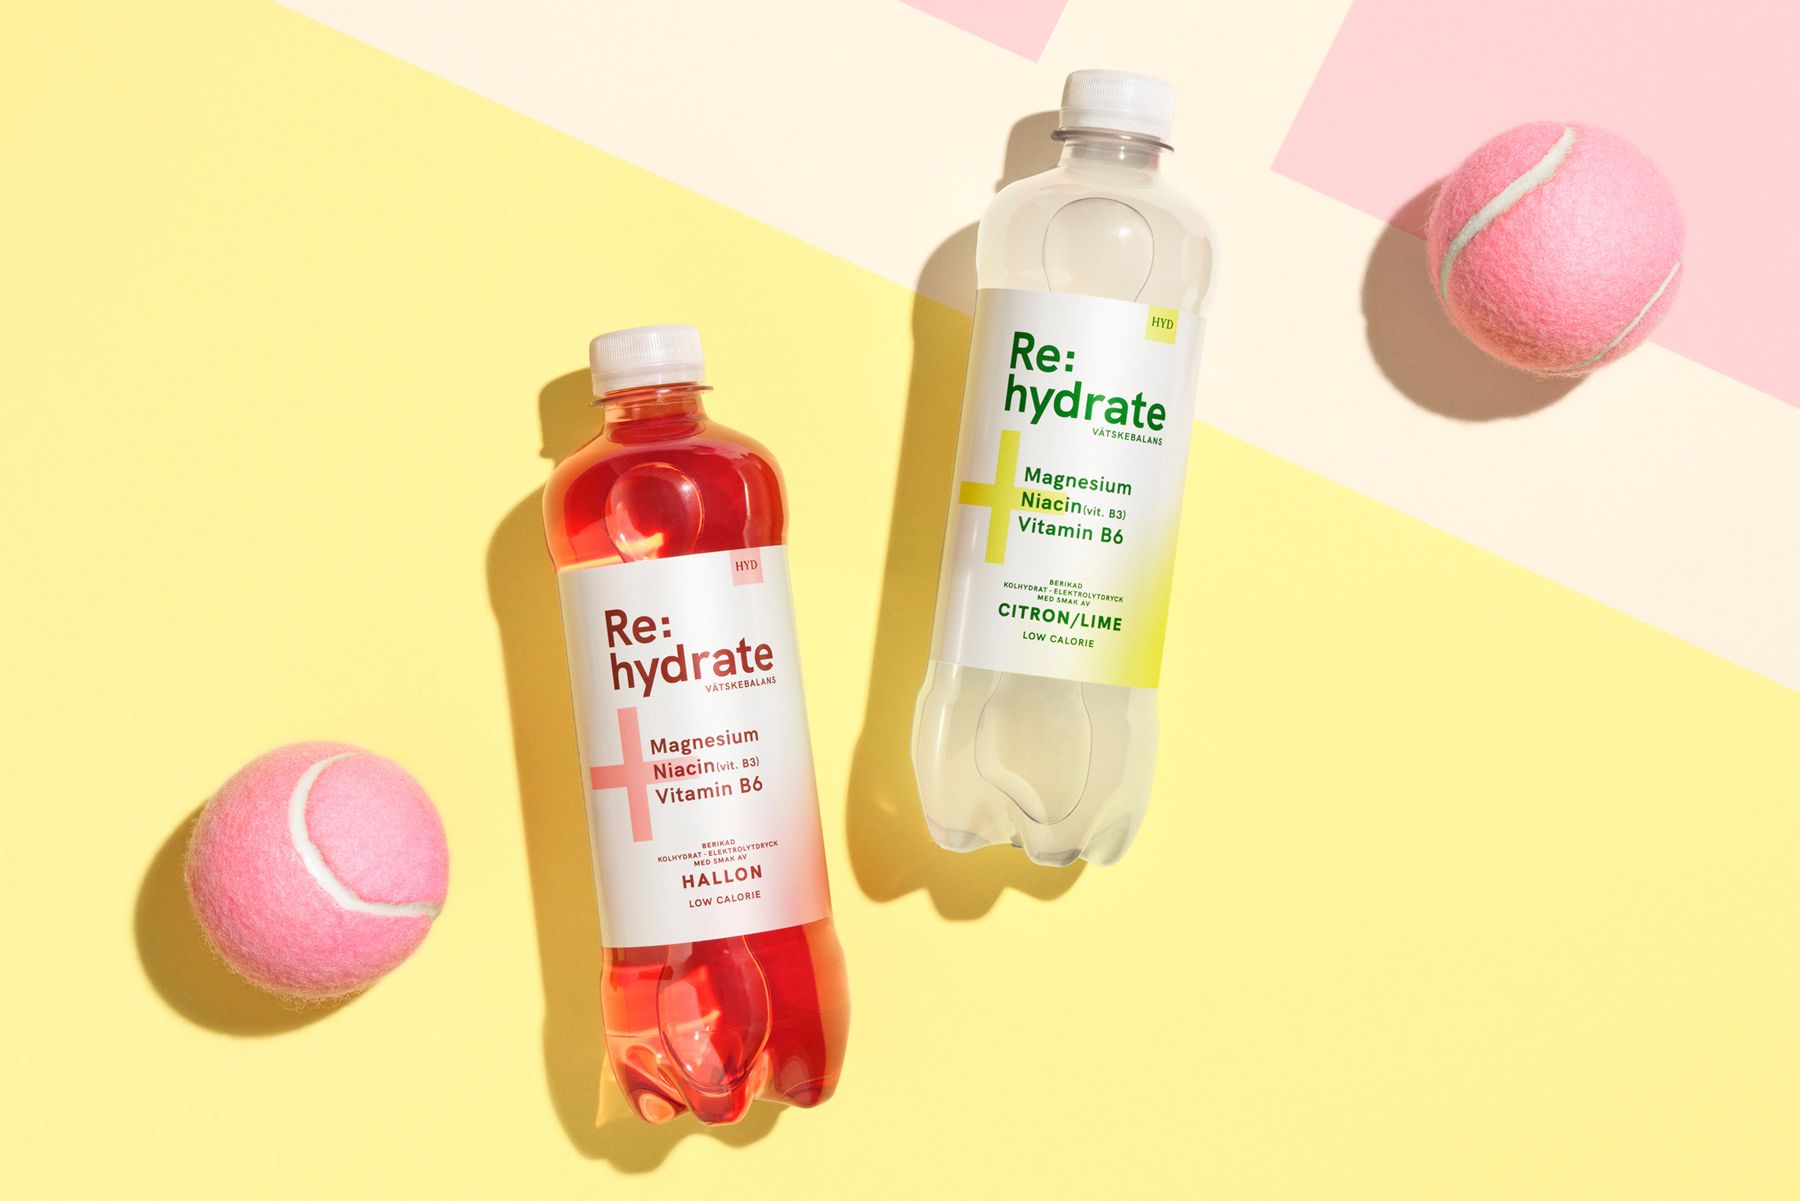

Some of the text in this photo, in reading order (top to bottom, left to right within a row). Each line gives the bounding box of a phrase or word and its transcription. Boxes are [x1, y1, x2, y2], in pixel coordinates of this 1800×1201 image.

[1152, 316, 1174, 330] HYD
[1010, 331, 1075, 373] Re:
[1004, 374, 1166, 432] hydrate
[1092, 427, 1163, 446] VÄTSKEBALANS
[1024, 466, 1132, 496] Magnesium
[1108, 508, 1127, 521] B3)
[1018, 515, 1124, 545] Vitamin B6
[735, 559, 758, 572] HYD
[1049, 579, 1083, 589] BERIKAD
[1037, 594, 1054, 602] MED
[1056, 596, 1078, 605] SMAK
[998, 602, 1123, 632] CITRON/LIME
[604, 608, 672, 648] Re:
[1022, 631, 1095, 648] LOW CALORIE
[610, 637, 774, 698] hydrate
[705, 675, 777, 694] VÄTSKEBALANS
[650, 729, 760, 756] Magnesium
[742, 756, 760, 768] B3)
[655, 775, 763, 805] Vitamin B6
[701, 839, 736, 850] BERIKAD
[693, 853, 748, 867] MED SMAK AV
[681, 864, 763, 889] HALLON
[688, 890, 762, 908] LOW CALORIE
